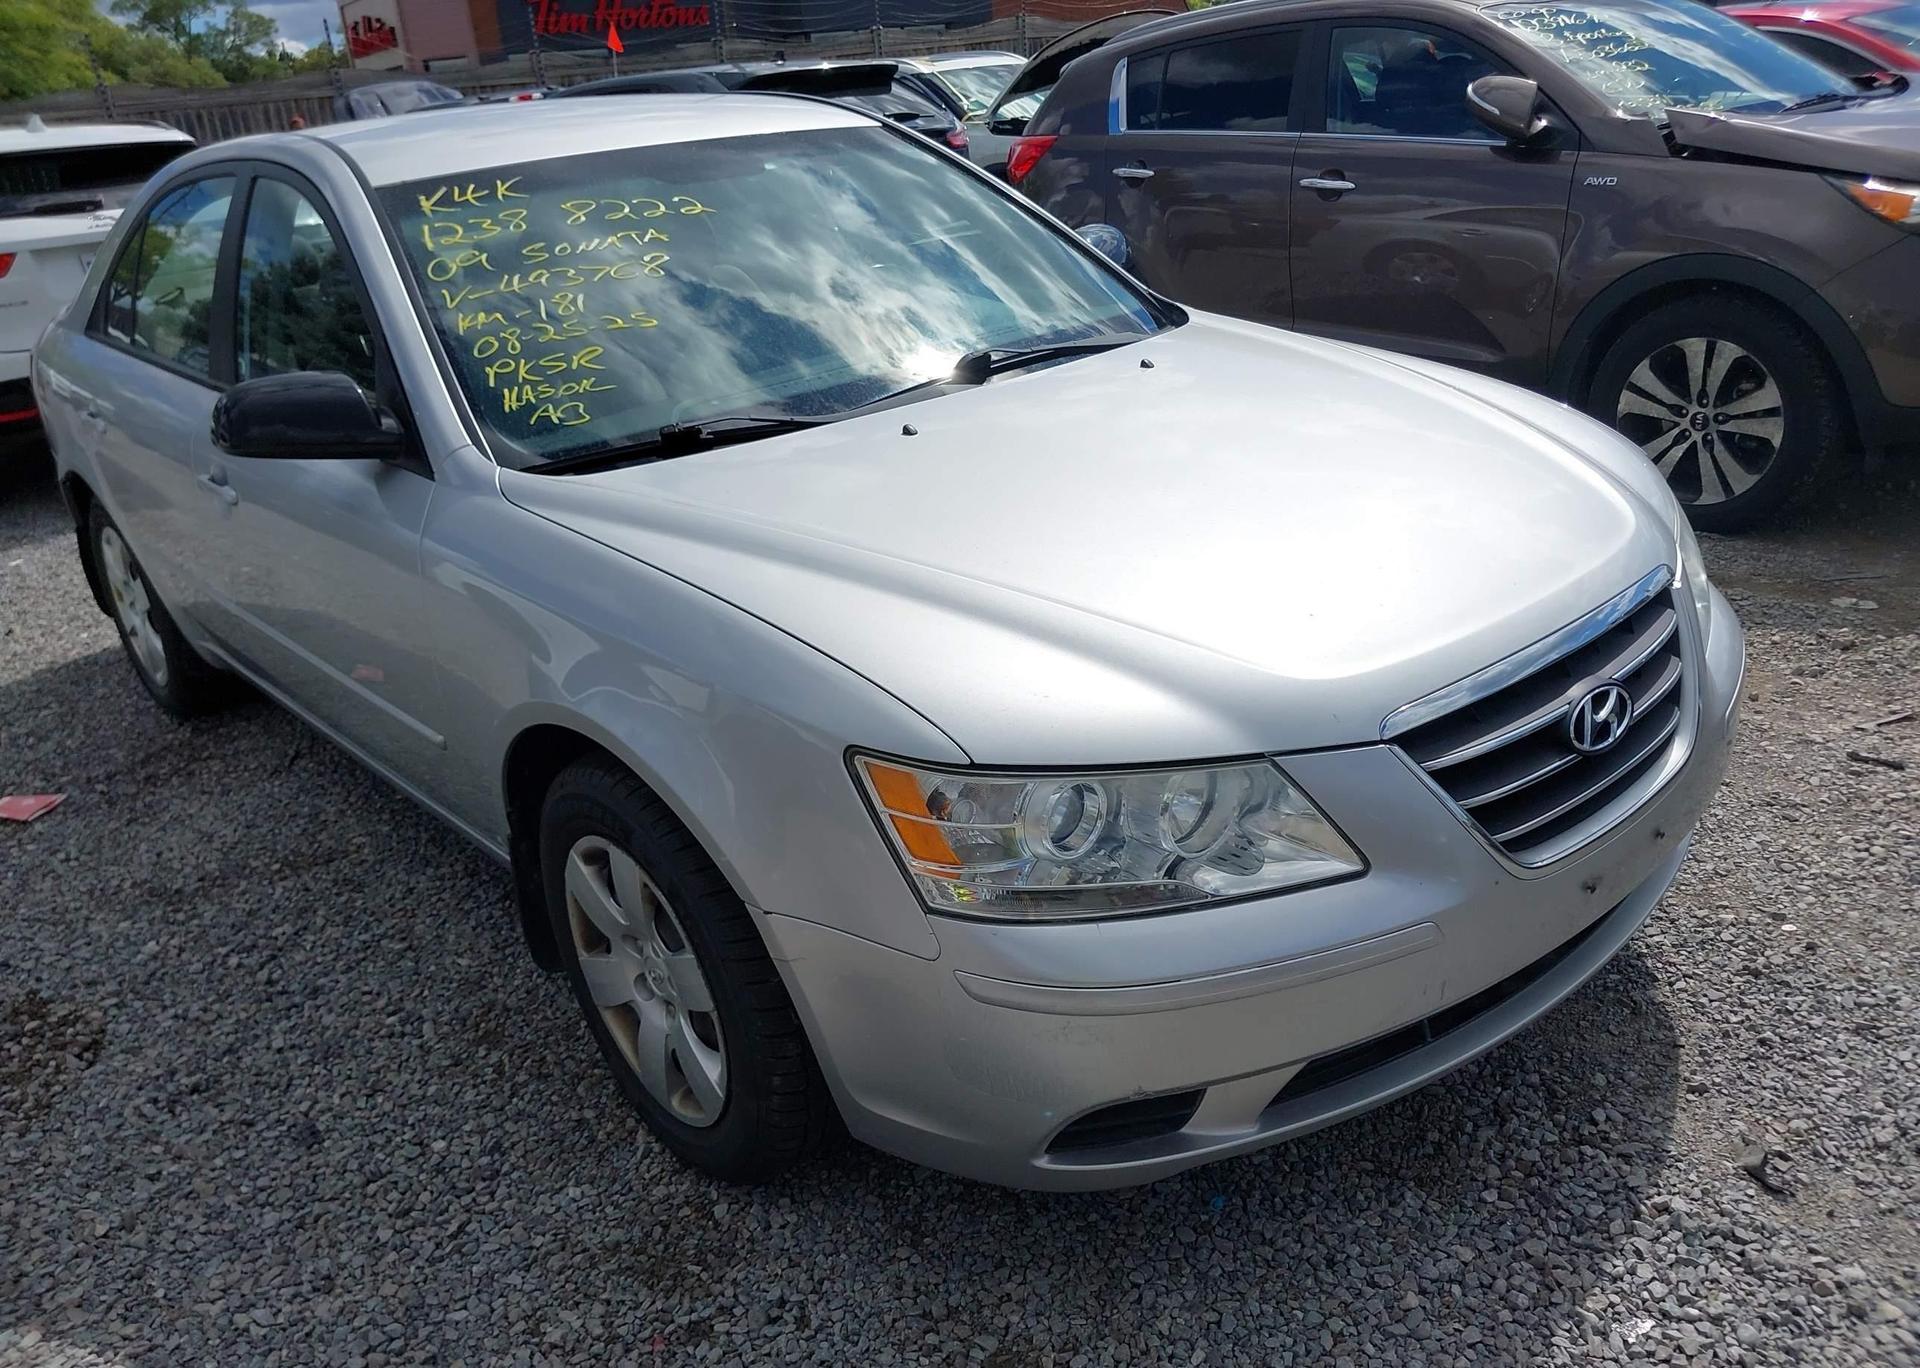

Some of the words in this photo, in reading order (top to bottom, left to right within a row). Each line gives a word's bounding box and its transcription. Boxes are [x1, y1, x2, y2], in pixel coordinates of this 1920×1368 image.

[525, 0, 588, 33] Tim
[593, 0, 710, 31] Hortons
[1584, 176, 1617, 186] AWD
[423, 208, 528, 251] 1238
[560, 197, 718, 225] 8222
[521, 228, 670, 264] SONATA
